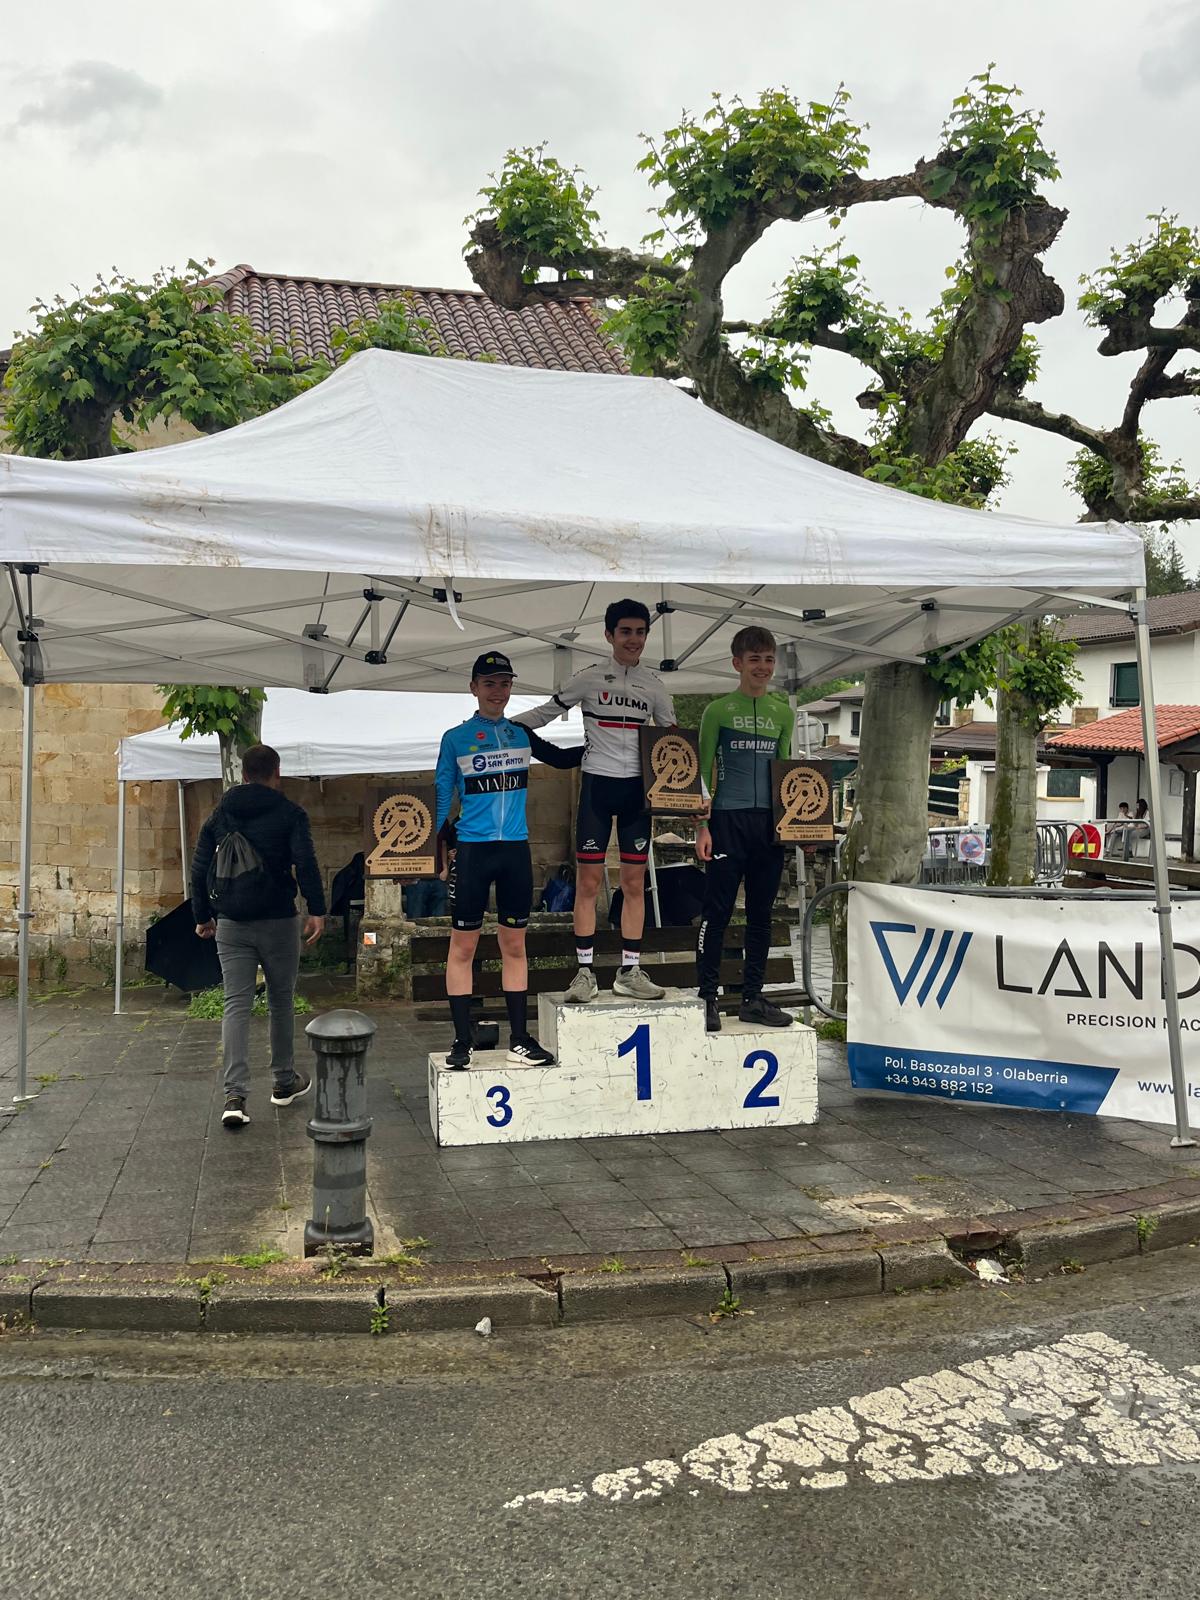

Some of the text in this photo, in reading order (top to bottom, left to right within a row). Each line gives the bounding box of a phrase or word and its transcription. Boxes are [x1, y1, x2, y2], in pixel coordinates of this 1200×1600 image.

[615, 697, 648, 712] ULMA
[733, 716, 775, 730] BESA
[1066, 1013, 1156, 1029] PRECISION
[617, 1024, 652, 1101] 1
[885, 1056, 907, 1070] Pol.
[910, 1059, 980, 1076] Basozabal
[984, 1066, 993, 1078] 3
[1003, 1068, 1068, 1084] Olaberria
[742, 1049, 780, 1109] 2
[885, 1073, 994, 1095] +34 943 882 152
[485, 1085, 513, 1128] 3
